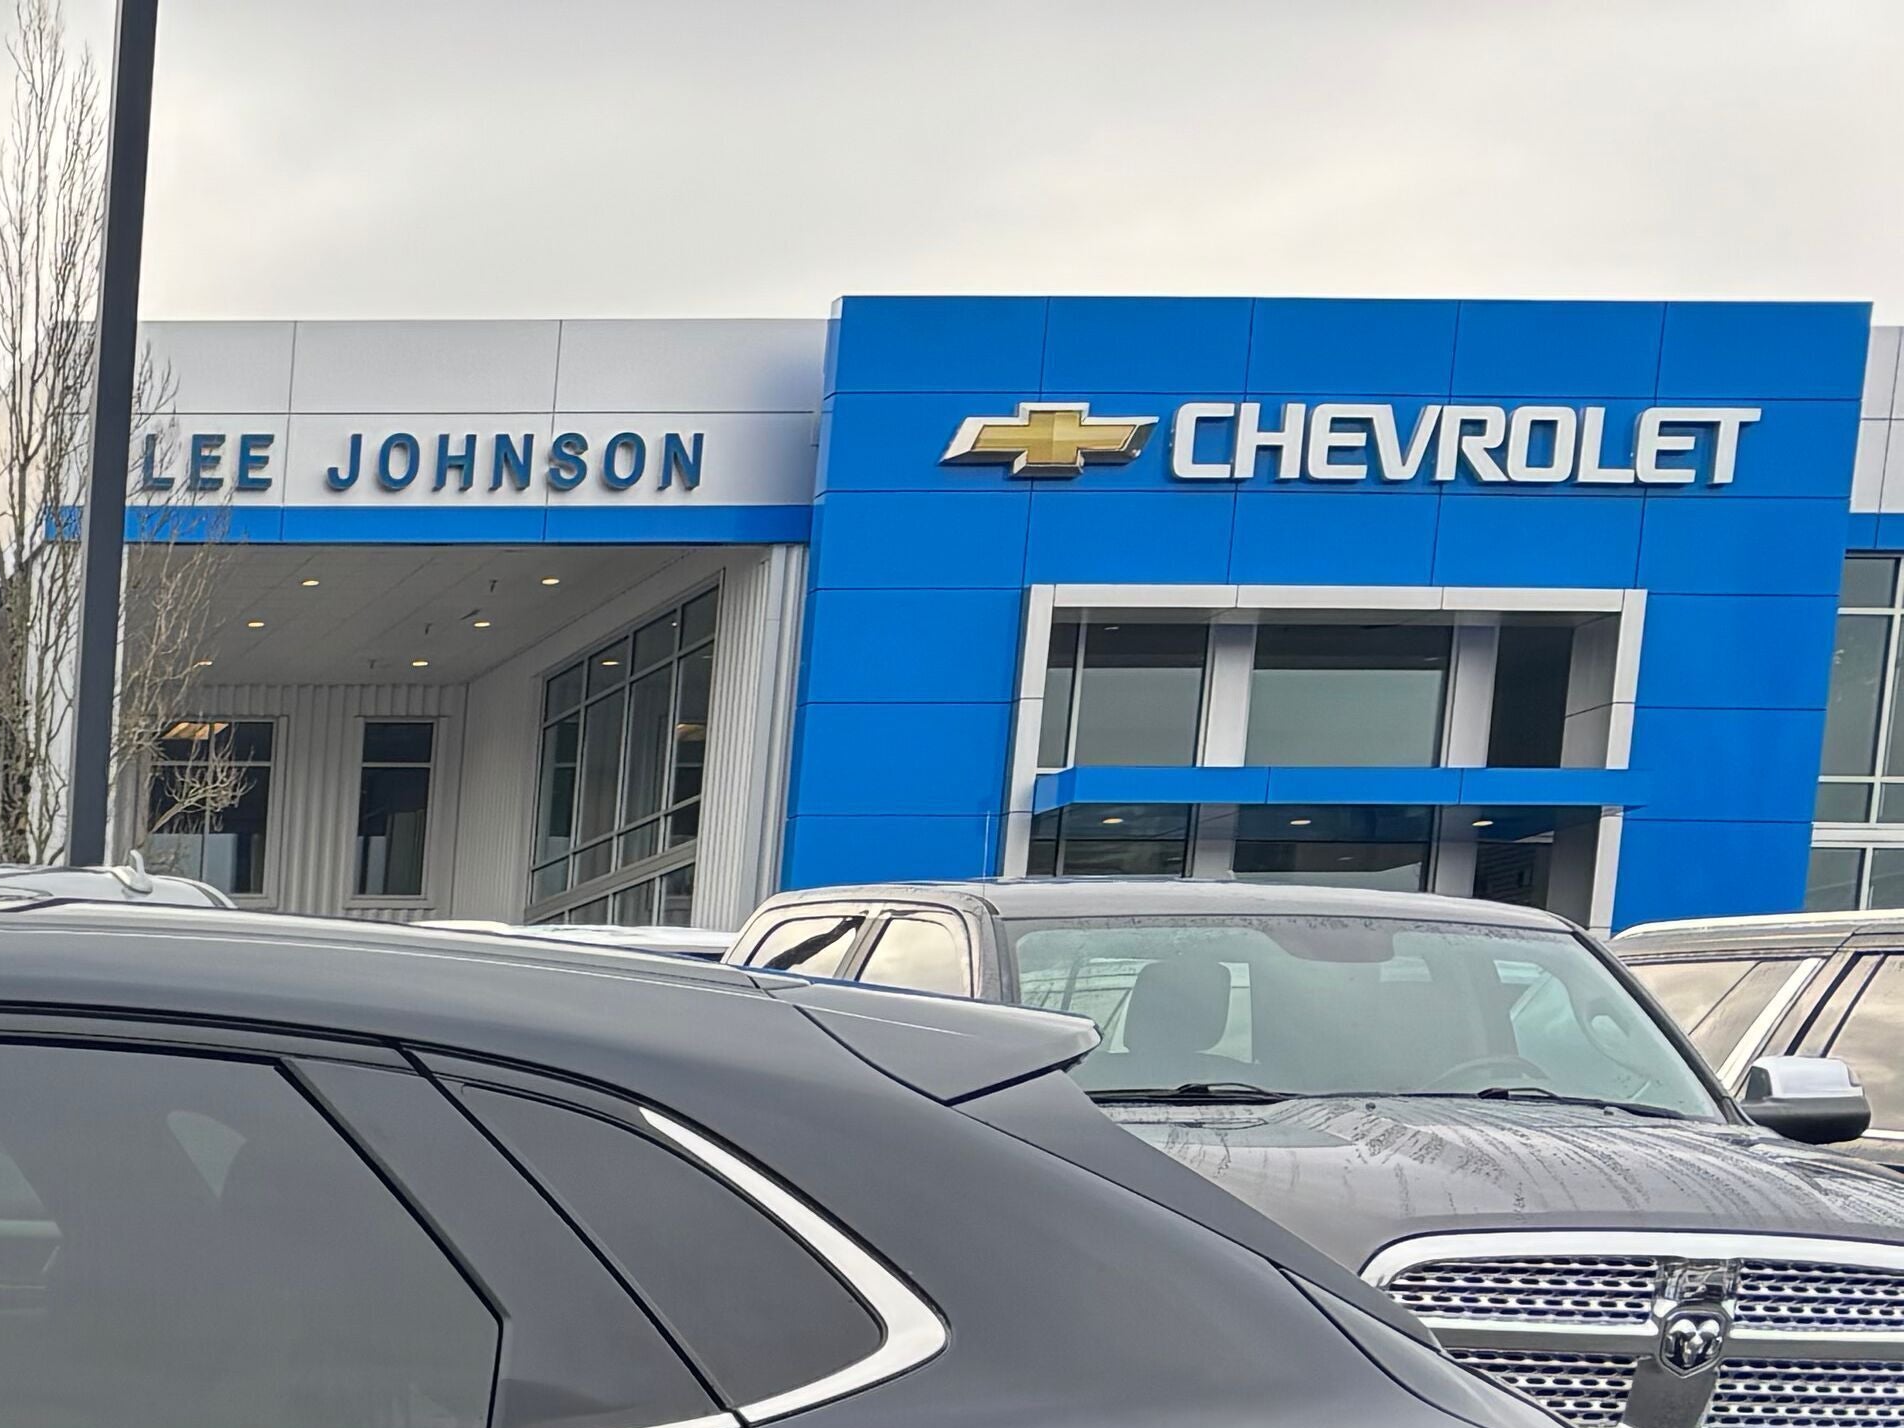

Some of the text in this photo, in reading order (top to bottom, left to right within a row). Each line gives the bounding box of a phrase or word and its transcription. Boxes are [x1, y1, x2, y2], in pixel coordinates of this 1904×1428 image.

[143, 433, 705, 492] LEE JOHNSON
[1171, 402, 1763, 484] CHEVROLET
